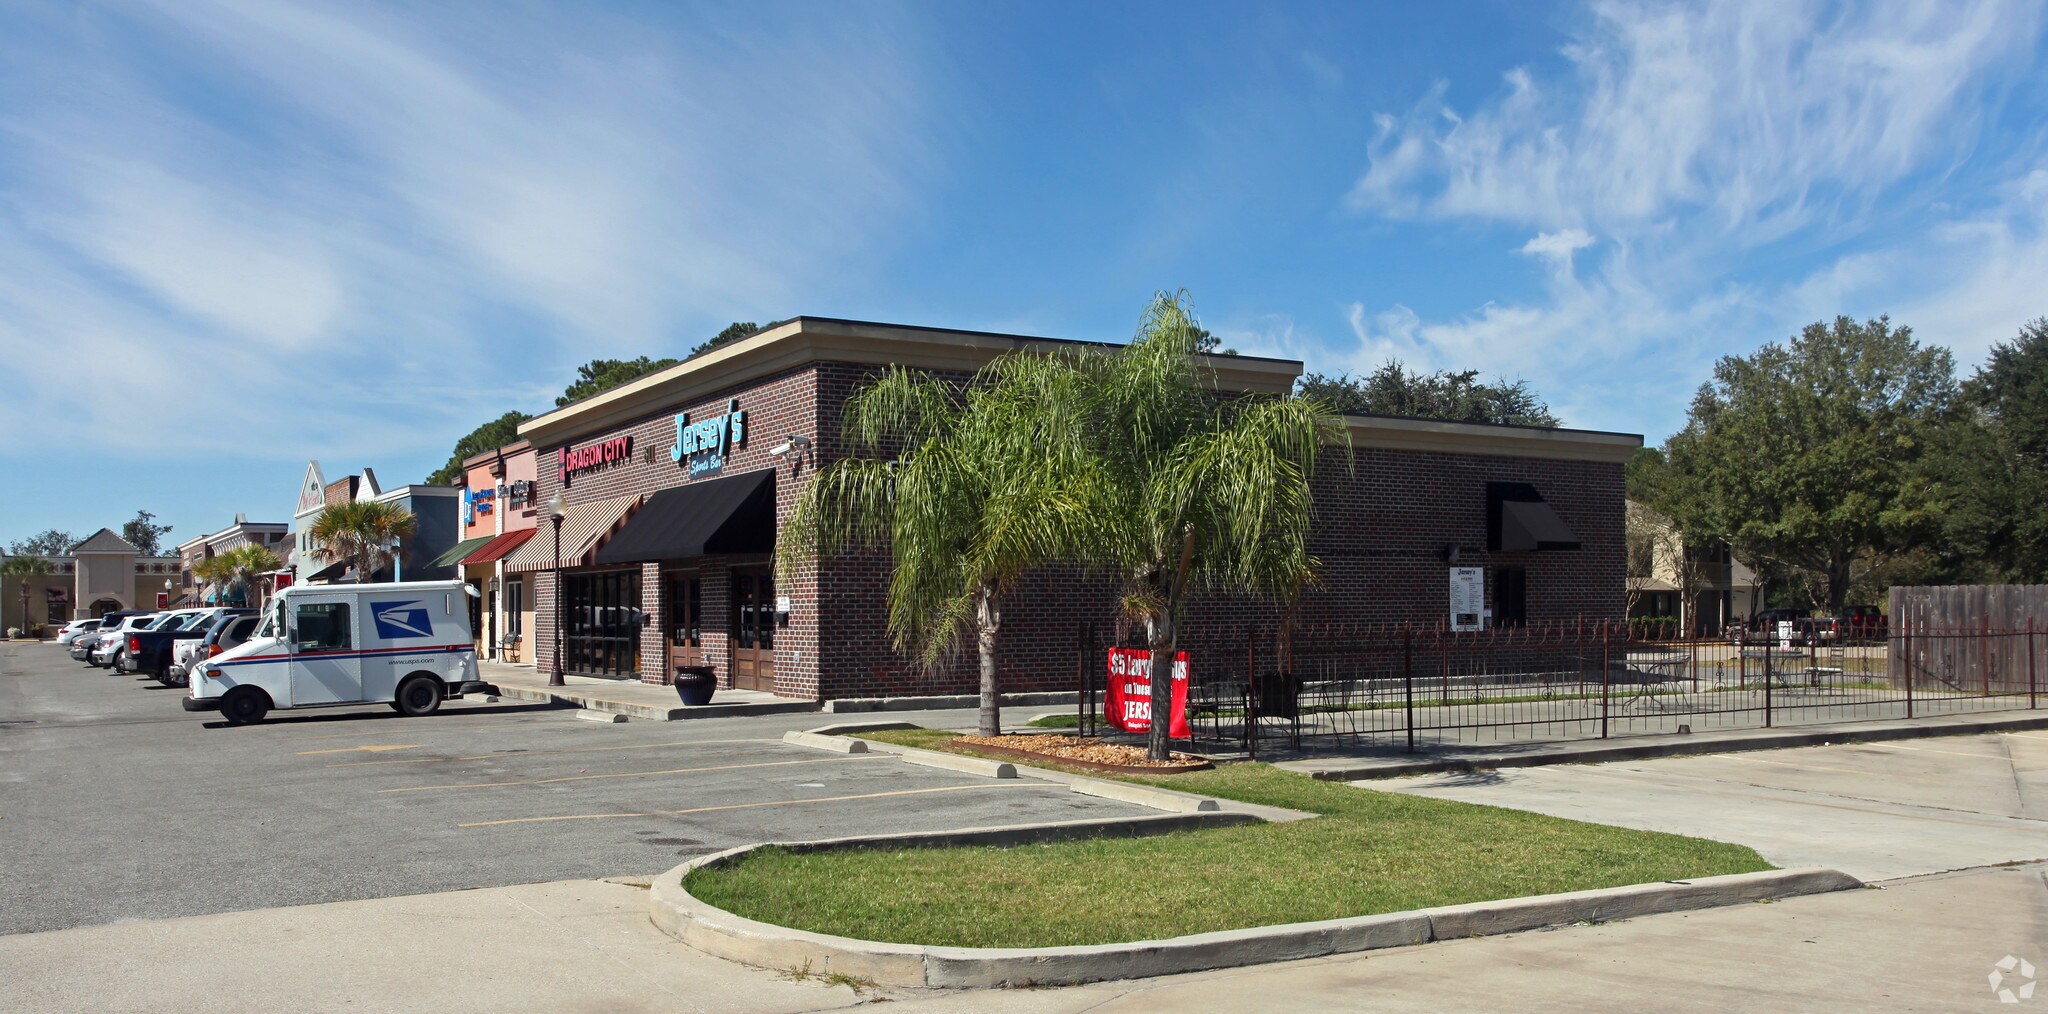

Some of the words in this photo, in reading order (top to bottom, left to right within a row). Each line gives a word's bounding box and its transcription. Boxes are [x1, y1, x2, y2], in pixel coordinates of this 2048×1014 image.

[671, 399, 743, 461] Jersey's
[566, 443, 602, 472] DRAGON
[604, 436, 628, 461] CITY
[690, 459, 709, 475] Sports
[710, 454, 721, 470] Bar
[388, 658, 435, 666] www.usps.com
[1111, 652, 1126, 677] $5
[1127, 655, 1151, 679] Larg
[1122, 701, 1151, 721] JERS
